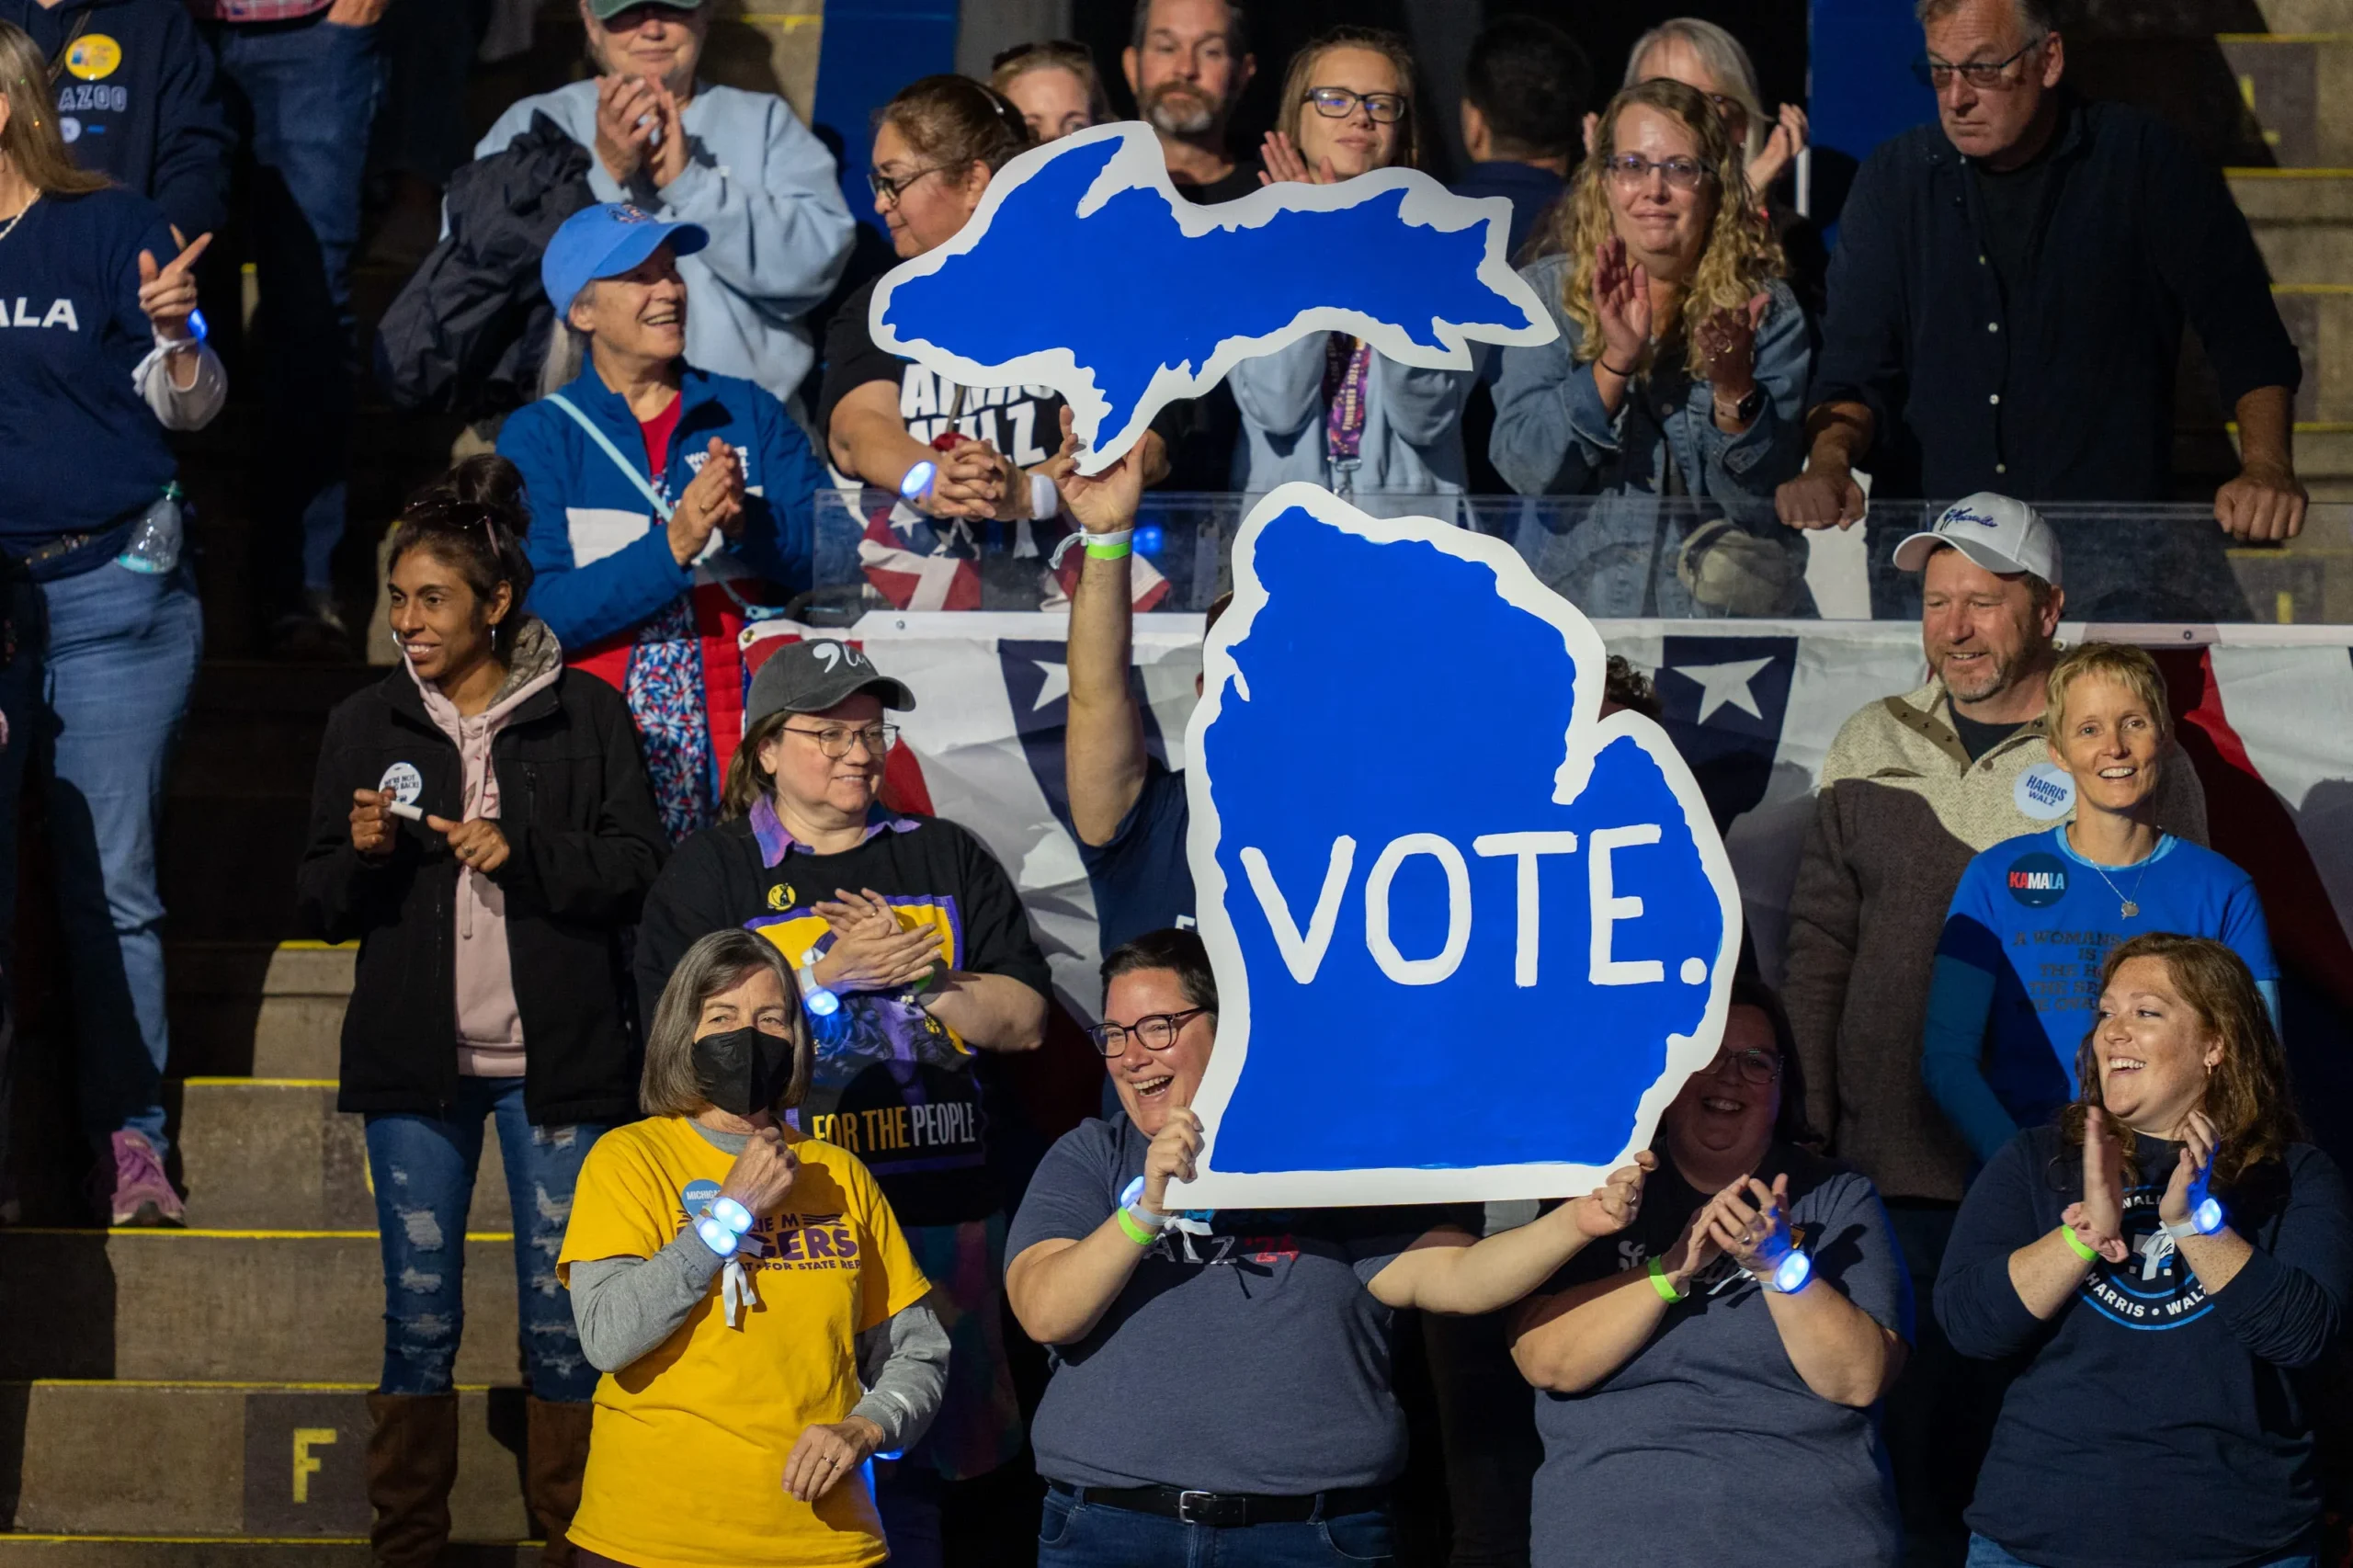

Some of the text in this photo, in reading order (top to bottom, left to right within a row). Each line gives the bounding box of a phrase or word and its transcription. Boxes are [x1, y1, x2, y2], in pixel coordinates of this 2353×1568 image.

[2026, 775, 2067, 801] HARRIS
[2029, 790, 2056, 807] WALZ
[2009, 871, 2064, 890] KAMALA
[1240, 824, 1707, 987] VOTE.
[2014, 931, 2027, 947] A
[2040, 963, 2079, 977] THE
[2029, 981, 2068, 995] THE
[813, 1102, 975, 1153] FOR THE PEOPLE
[1143, 1233, 1238, 1265] ALZ
[765, 1262, 793, 1271] FOR
[799, 1259, 836, 1270] STATE
[2085, 1272, 2145, 1318] HARRIS
[292, 1428, 336, 1504] F
